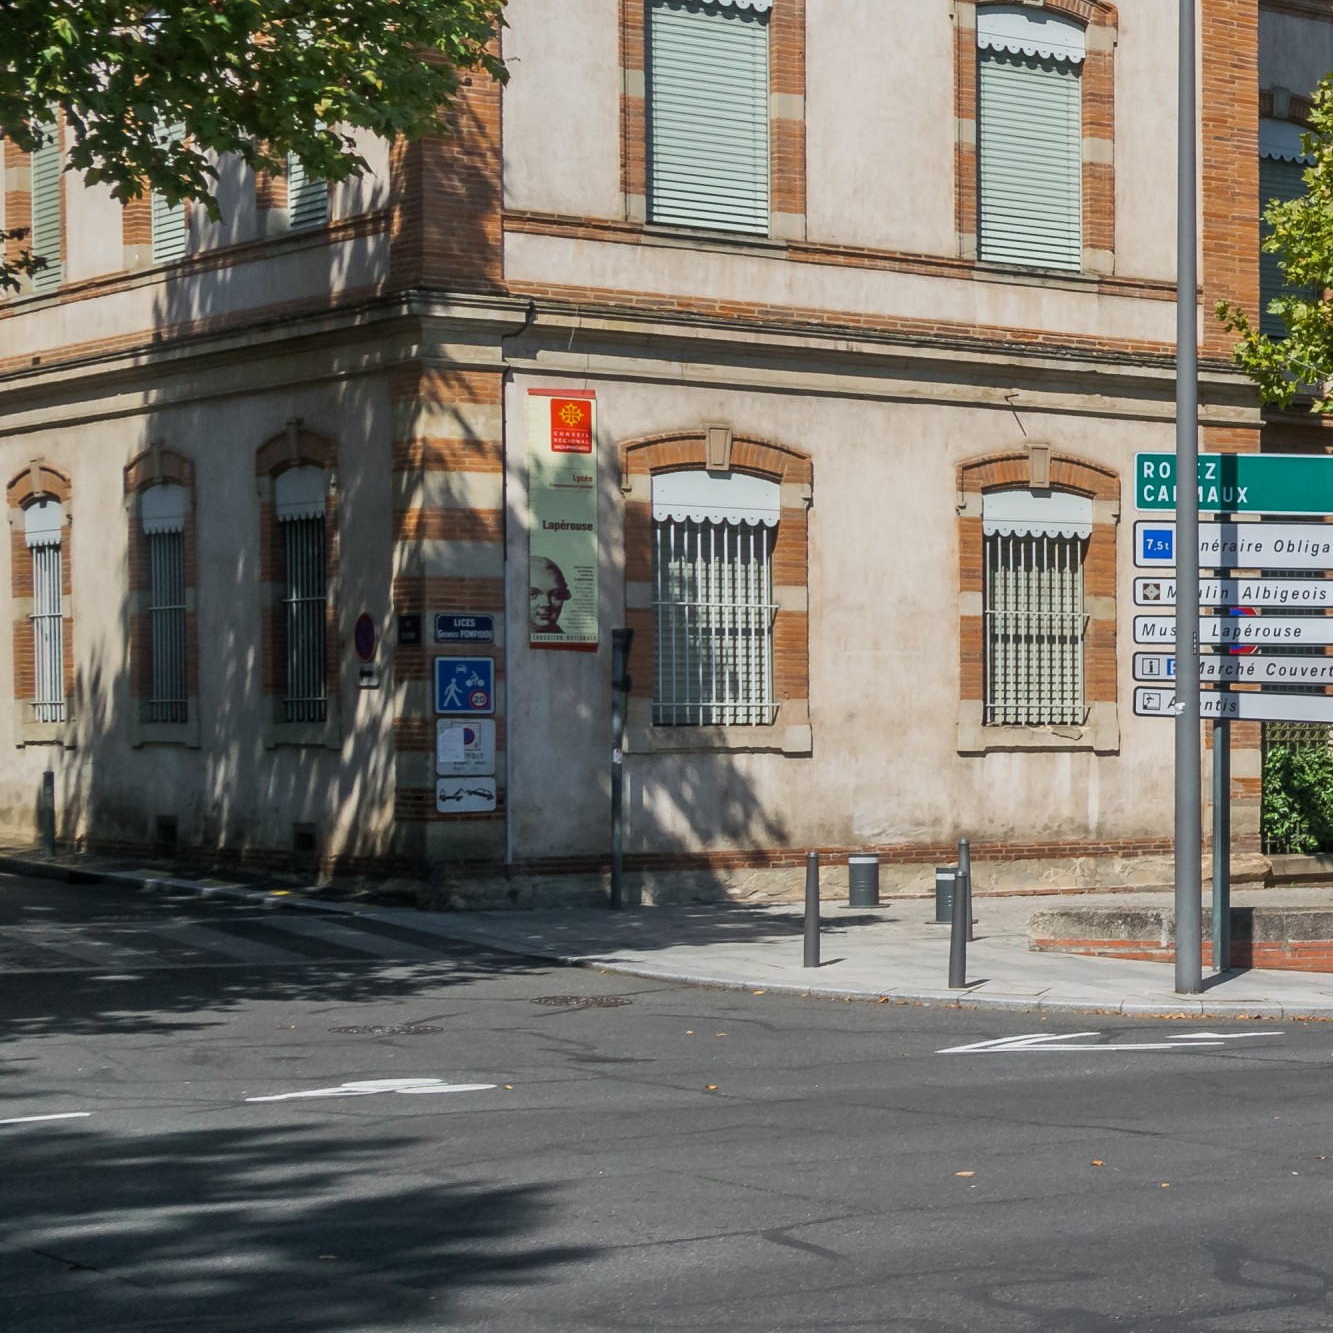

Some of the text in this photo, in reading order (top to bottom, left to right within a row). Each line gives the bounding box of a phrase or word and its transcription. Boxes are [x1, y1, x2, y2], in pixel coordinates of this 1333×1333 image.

[1143, 462, 1216, 479] ROZ
[1143, 484, 1248, 503] CAAUX
[542, 519, 593, 532] Lapérouse
[1200, 539, 1263, 552] néraire
[1166, 585, 1327, 603] Mlin Albigeois
[453, 619, 476, 627] LICES
[1211, 623, 1302, 641] Lapérouse
[473, 695, 486, 703] 20
[1167, 696, 1237, 712] Antis
